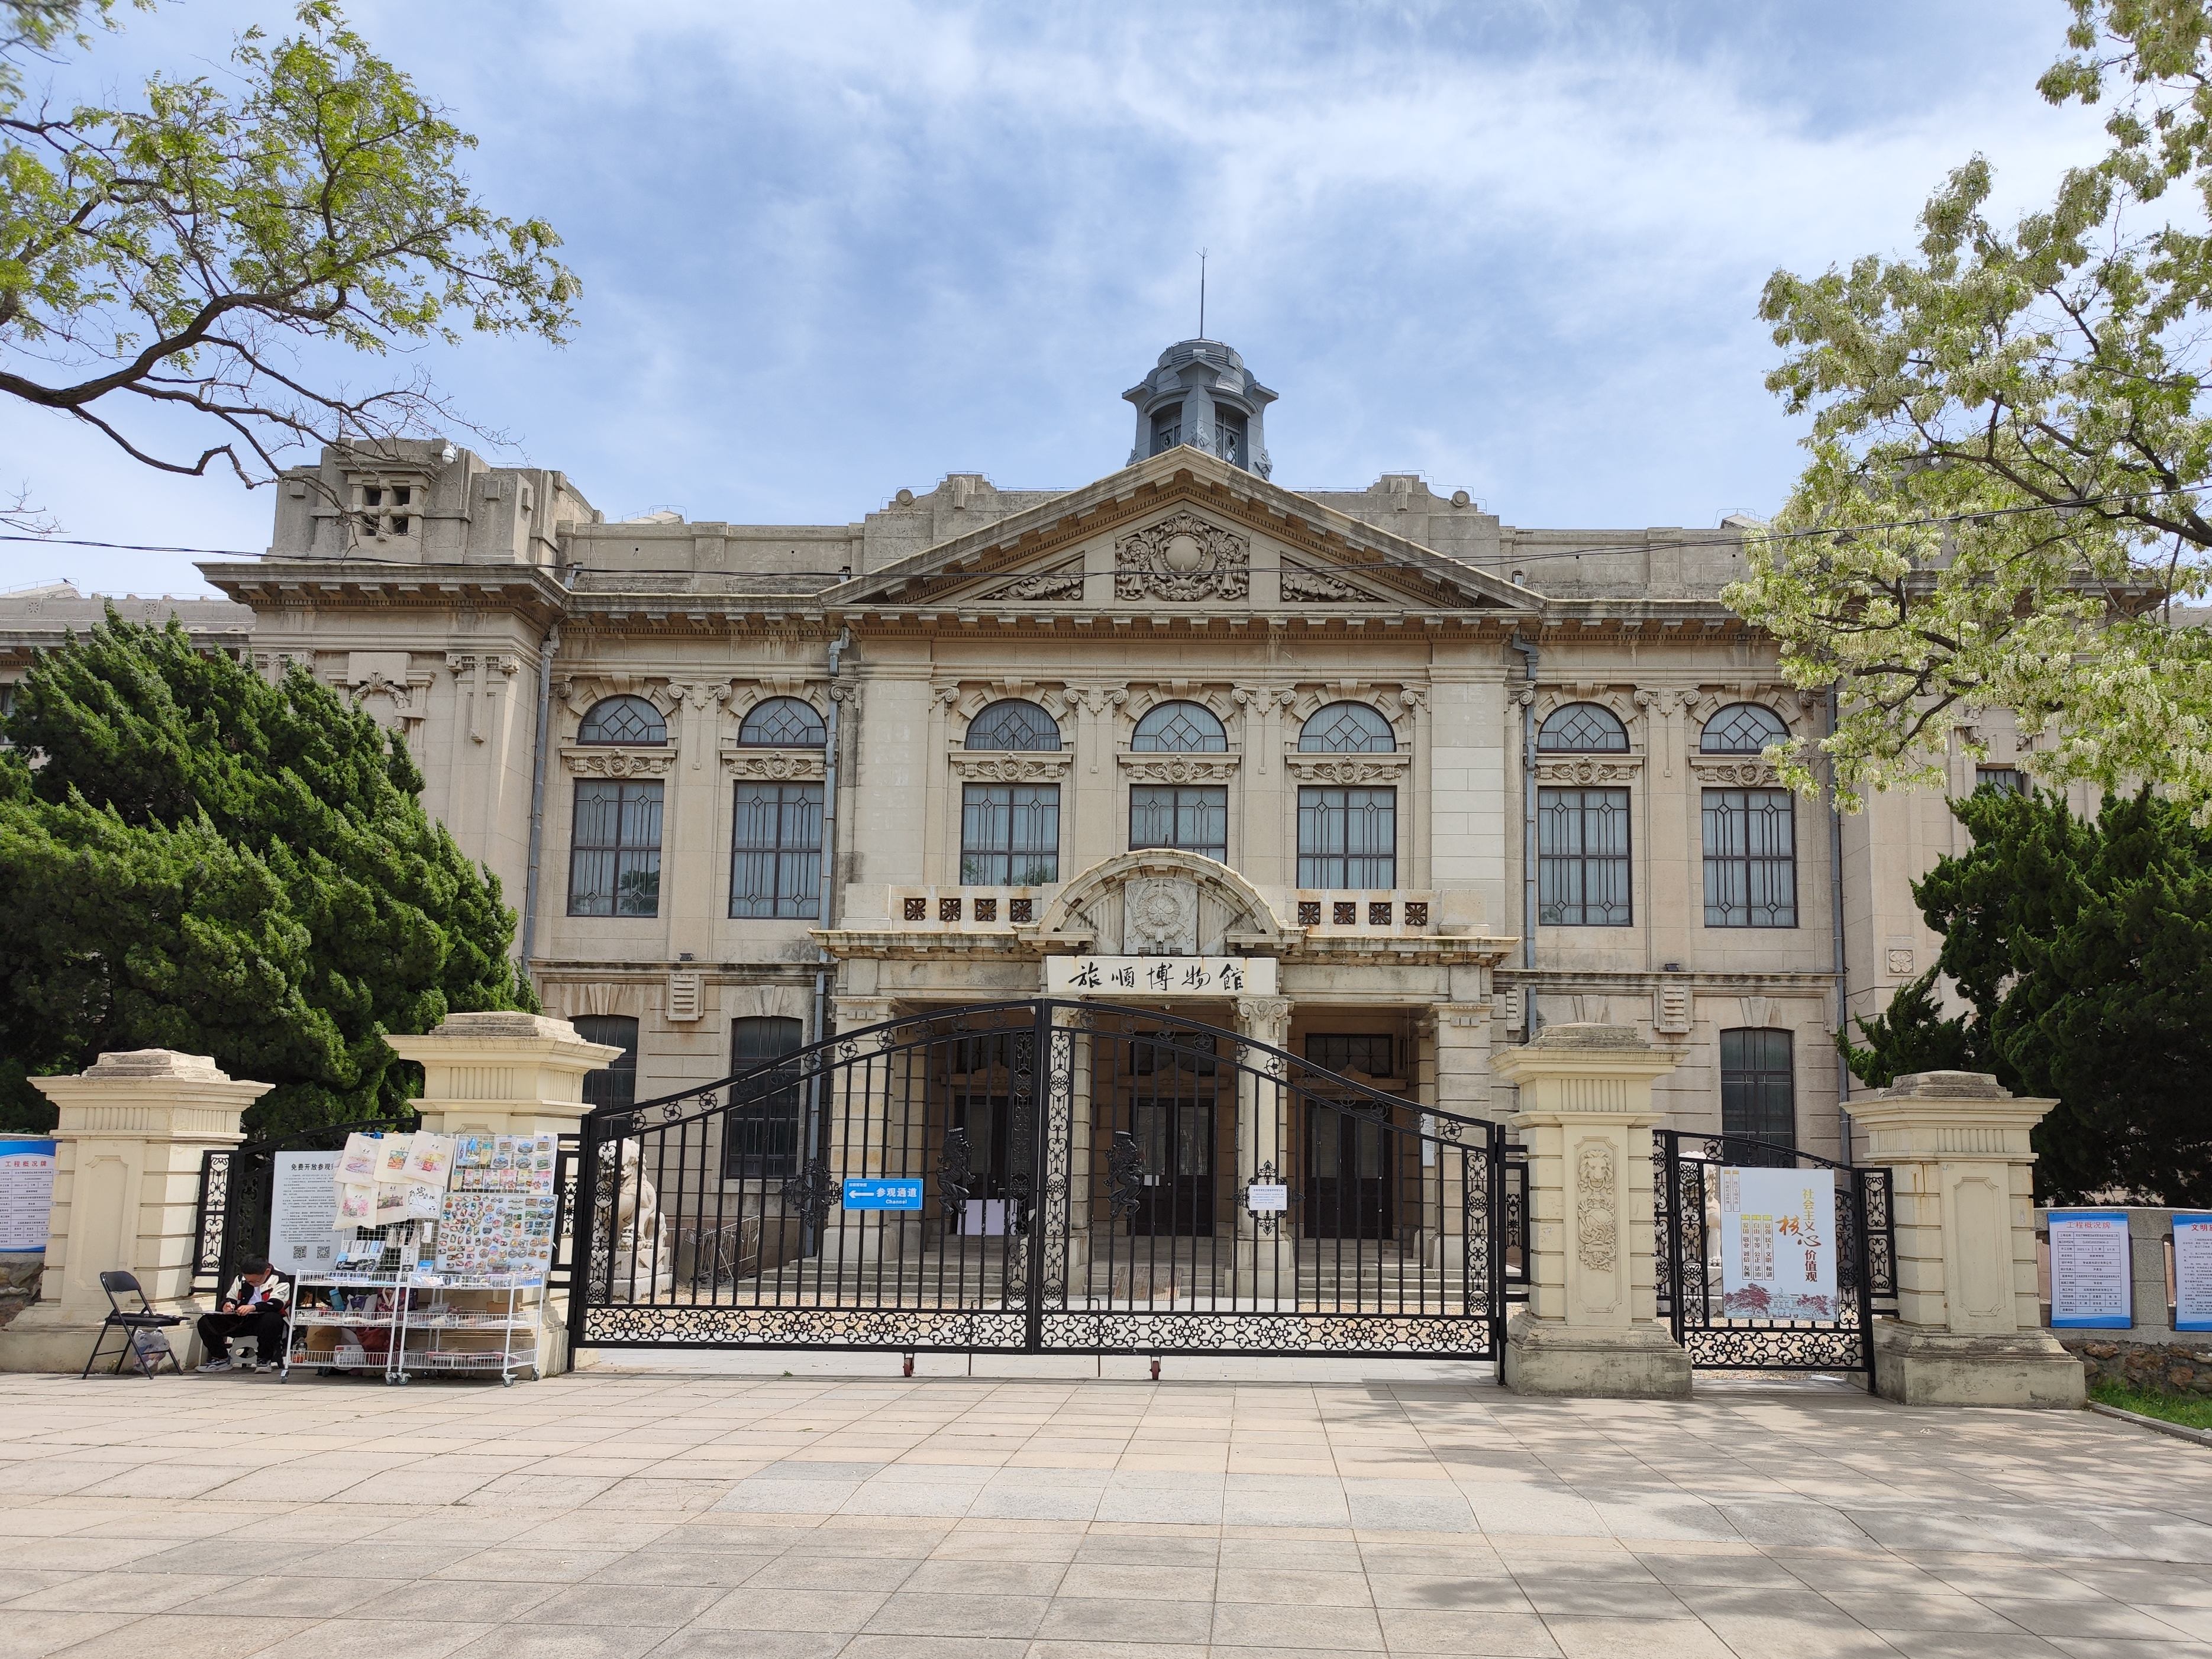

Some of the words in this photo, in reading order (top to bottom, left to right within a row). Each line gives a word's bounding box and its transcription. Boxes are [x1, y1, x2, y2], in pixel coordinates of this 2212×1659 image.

[1068, 961, 1245, 992] 旅順博物館
[876, 1187, 917, 1198] 参观通道
[1803, 1188, 1816, 1231] 社会主义
[1804, 1249, 1817, 1282] 价值观
